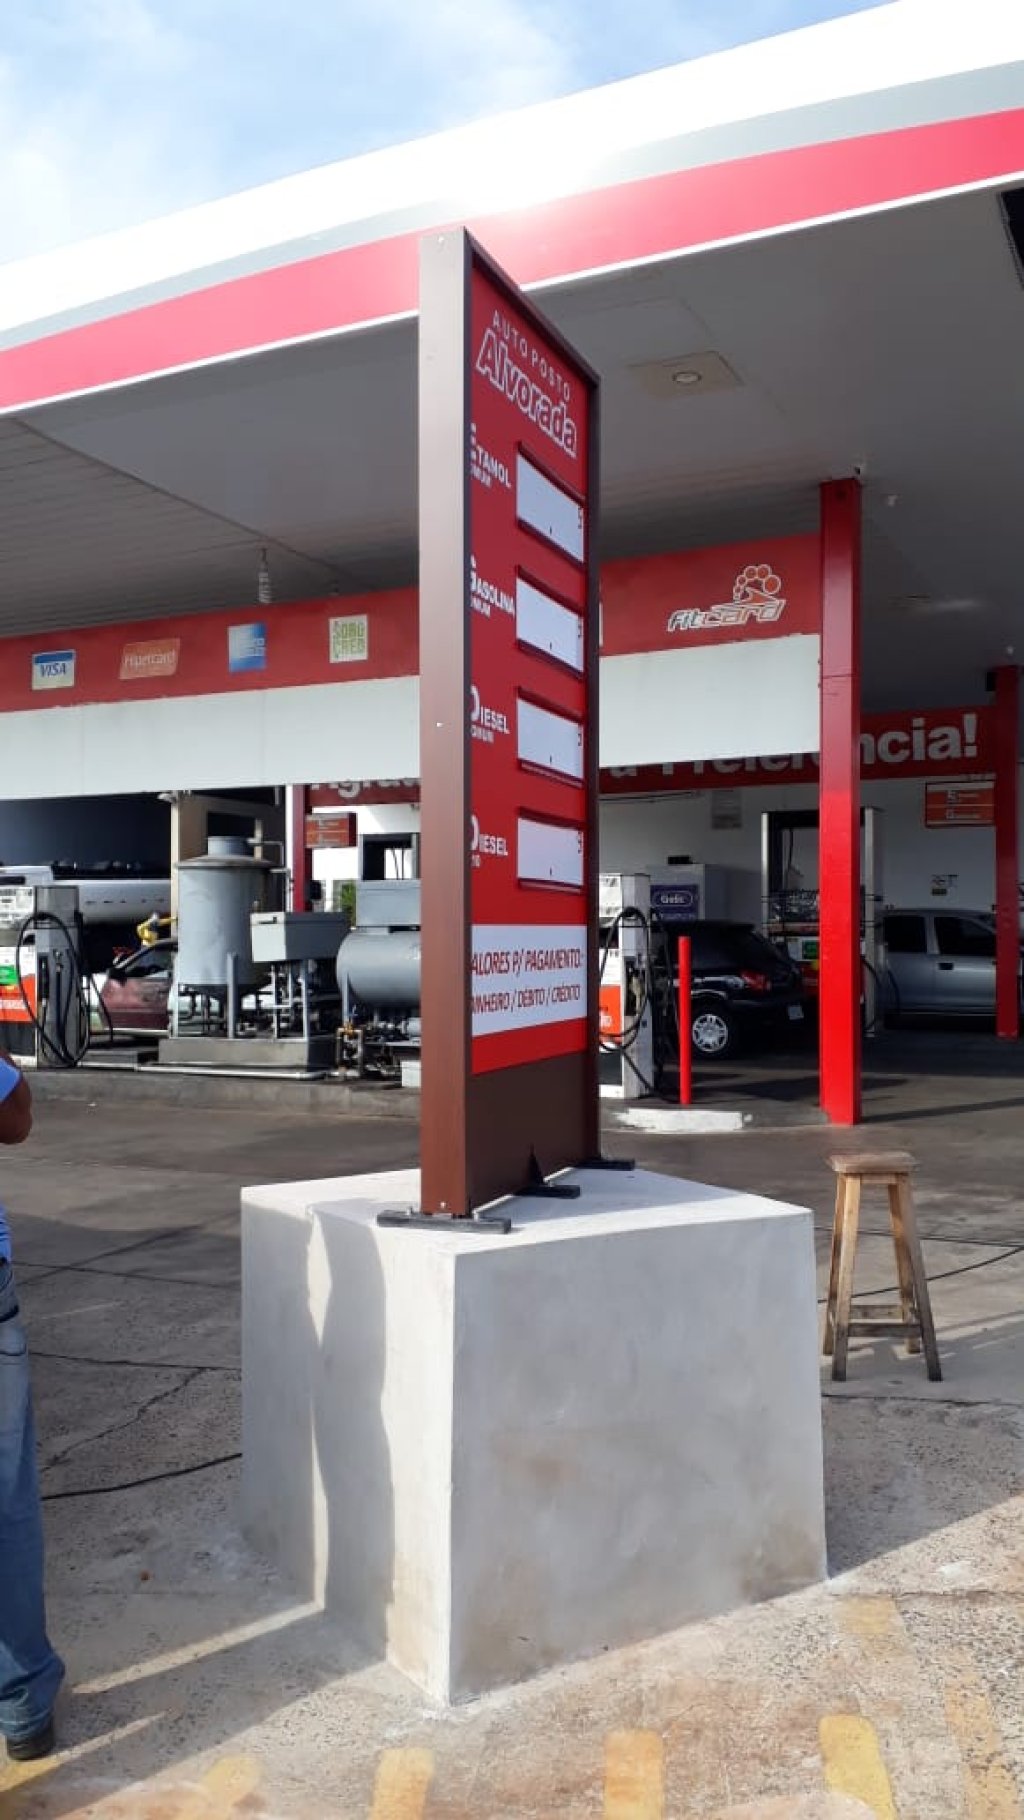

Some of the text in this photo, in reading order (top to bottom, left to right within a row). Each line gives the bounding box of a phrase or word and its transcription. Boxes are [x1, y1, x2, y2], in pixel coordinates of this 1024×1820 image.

[475, 327, 578, 460] Alvorada
[492, 309, 570, 401] AUTO POSTO
[40, 662, 67, 678] VISA
